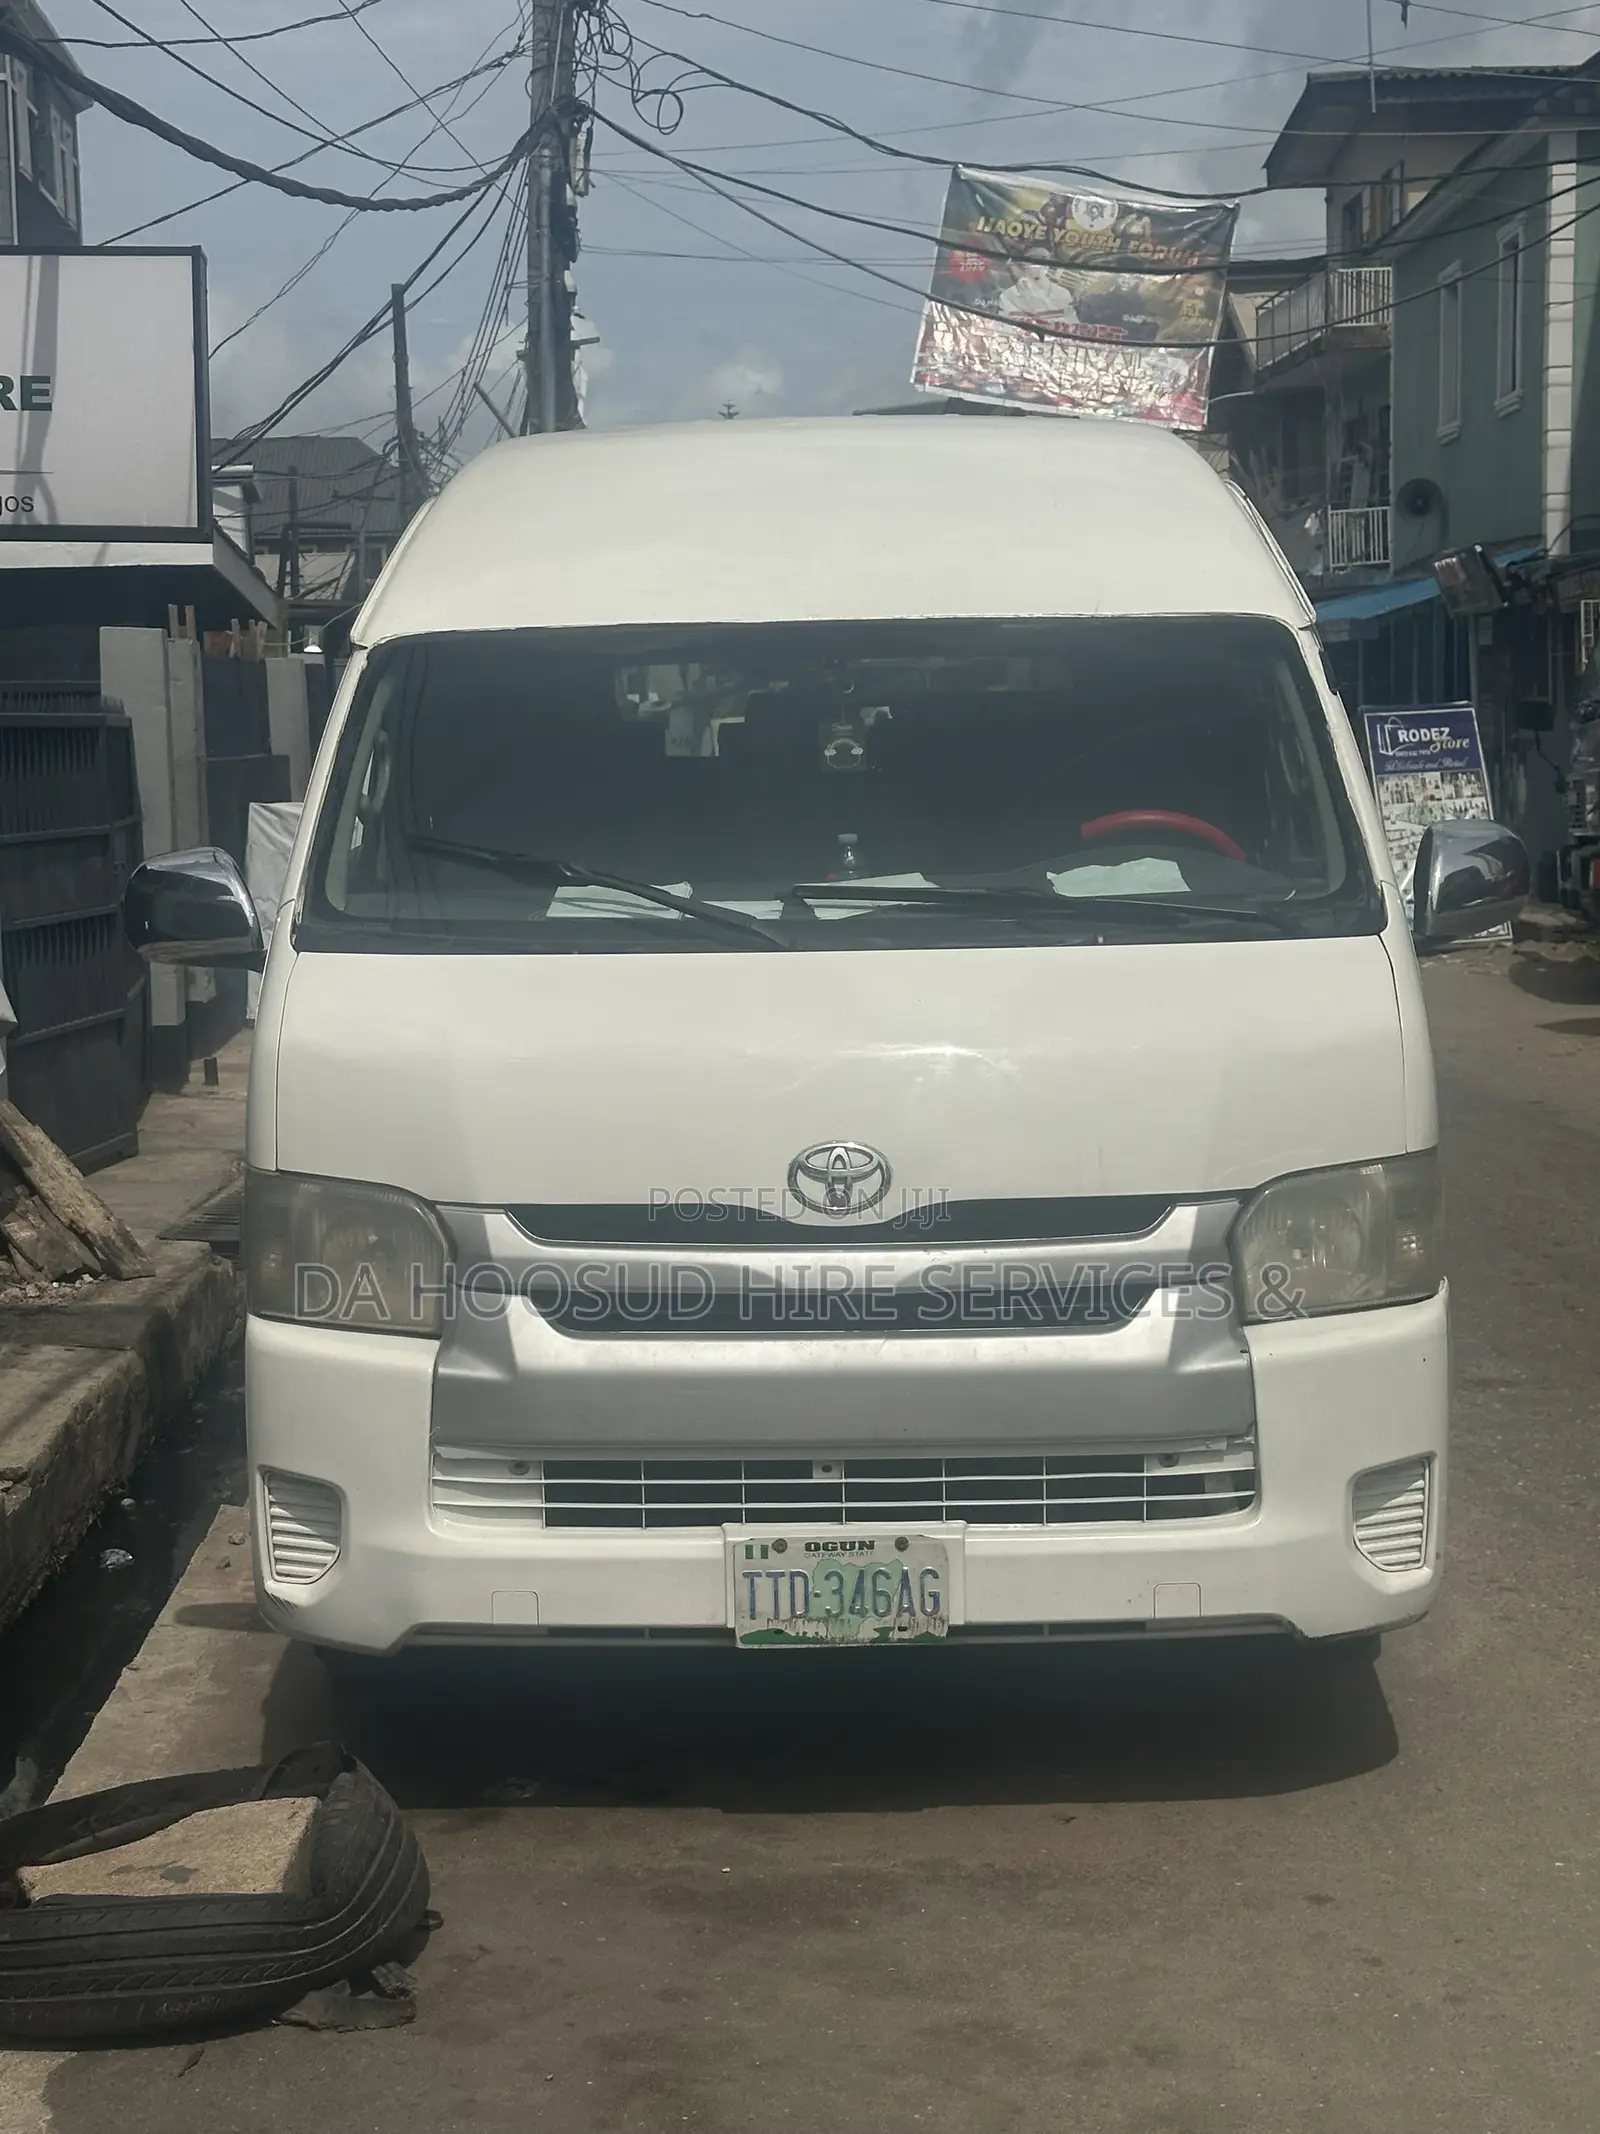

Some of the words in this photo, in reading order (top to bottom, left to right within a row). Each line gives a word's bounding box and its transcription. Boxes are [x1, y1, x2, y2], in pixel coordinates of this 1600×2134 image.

[1053, 227, 1122, 252] YOUTH
[0, 375, 52, 411] RE
[1397, 726, 1451, 744] RODEZ
[1429, 735, 1471, 753] Store
[804, 1539, 876, 1552] OGUN
